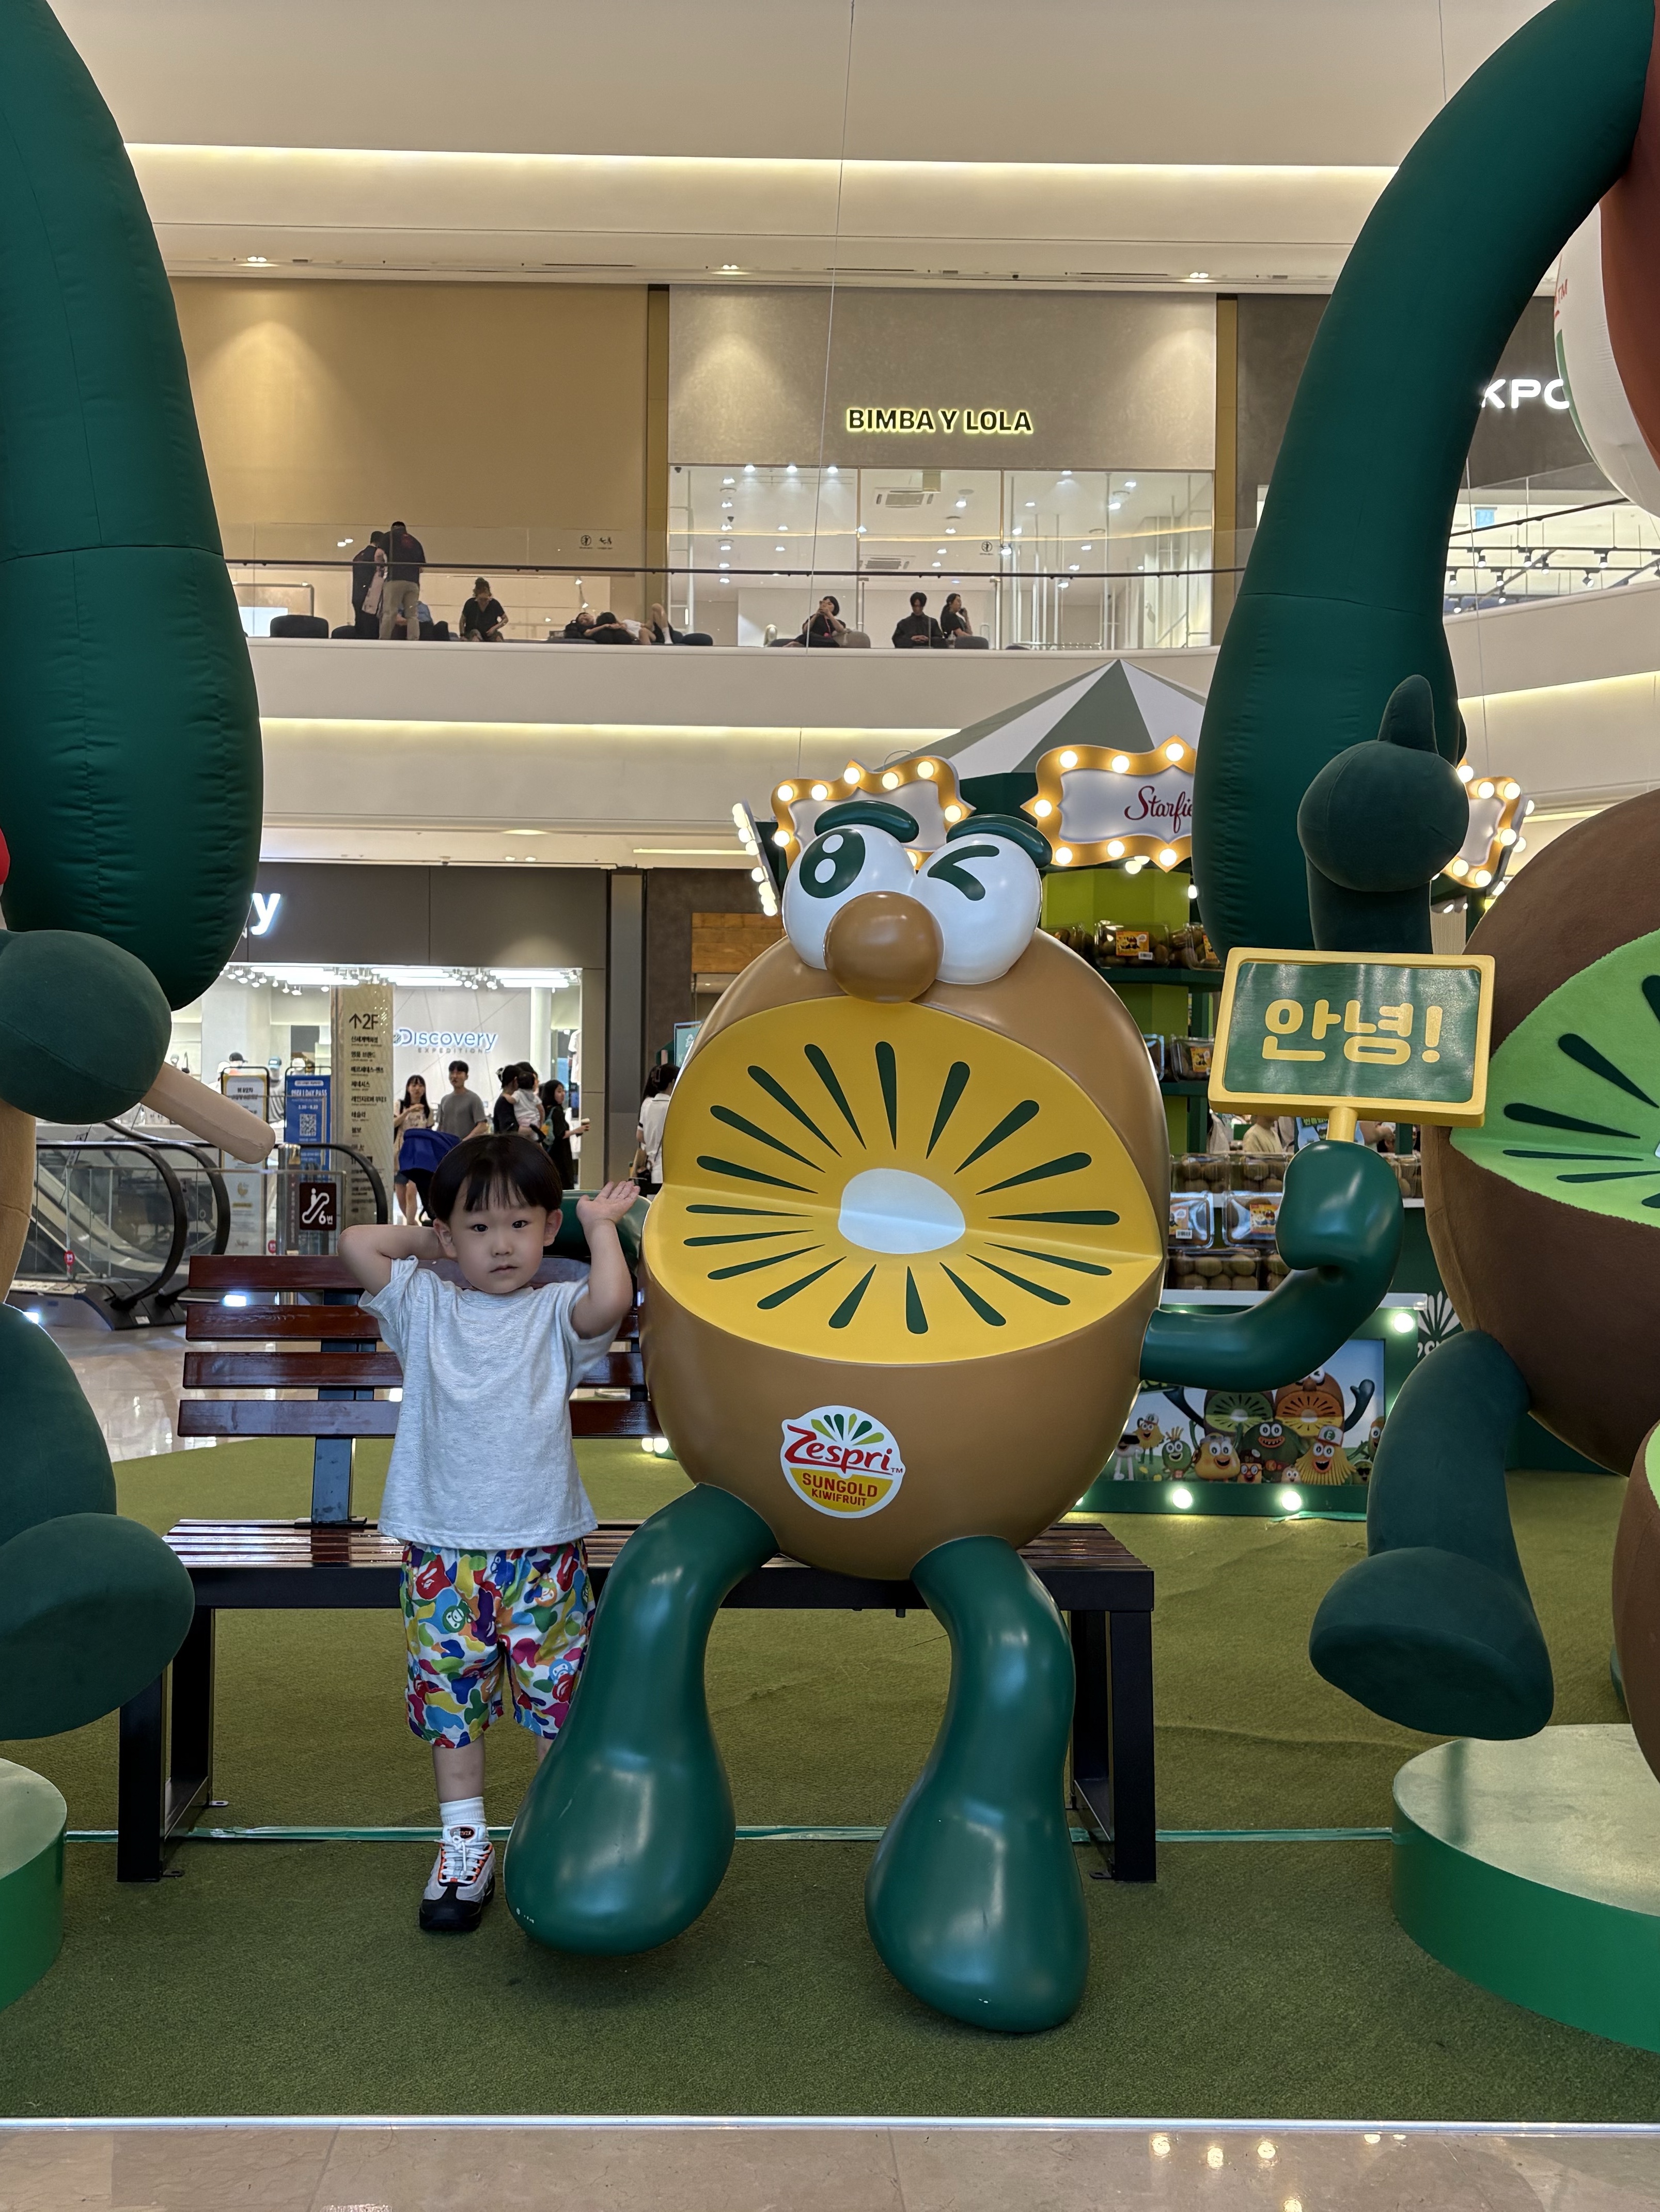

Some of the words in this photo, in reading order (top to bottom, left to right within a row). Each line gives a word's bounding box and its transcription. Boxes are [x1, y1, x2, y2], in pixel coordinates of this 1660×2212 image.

[849, 409, 934, 430] BIMBA
[941, 410, 958, 430] Y
[966, 410, 1032, 431] LOLA
[363, 1014, 379, 1030] 2F
[1262, 999, 1443, 1065] 안녕!
[399, 1029, 497, 1051] Discovery
[785, 1424, 893, 1476] Zespri
[802, 1472, 878, 1497] SUNGOLD
[811, 1488, 867, 1507] KIWIFRUIT
